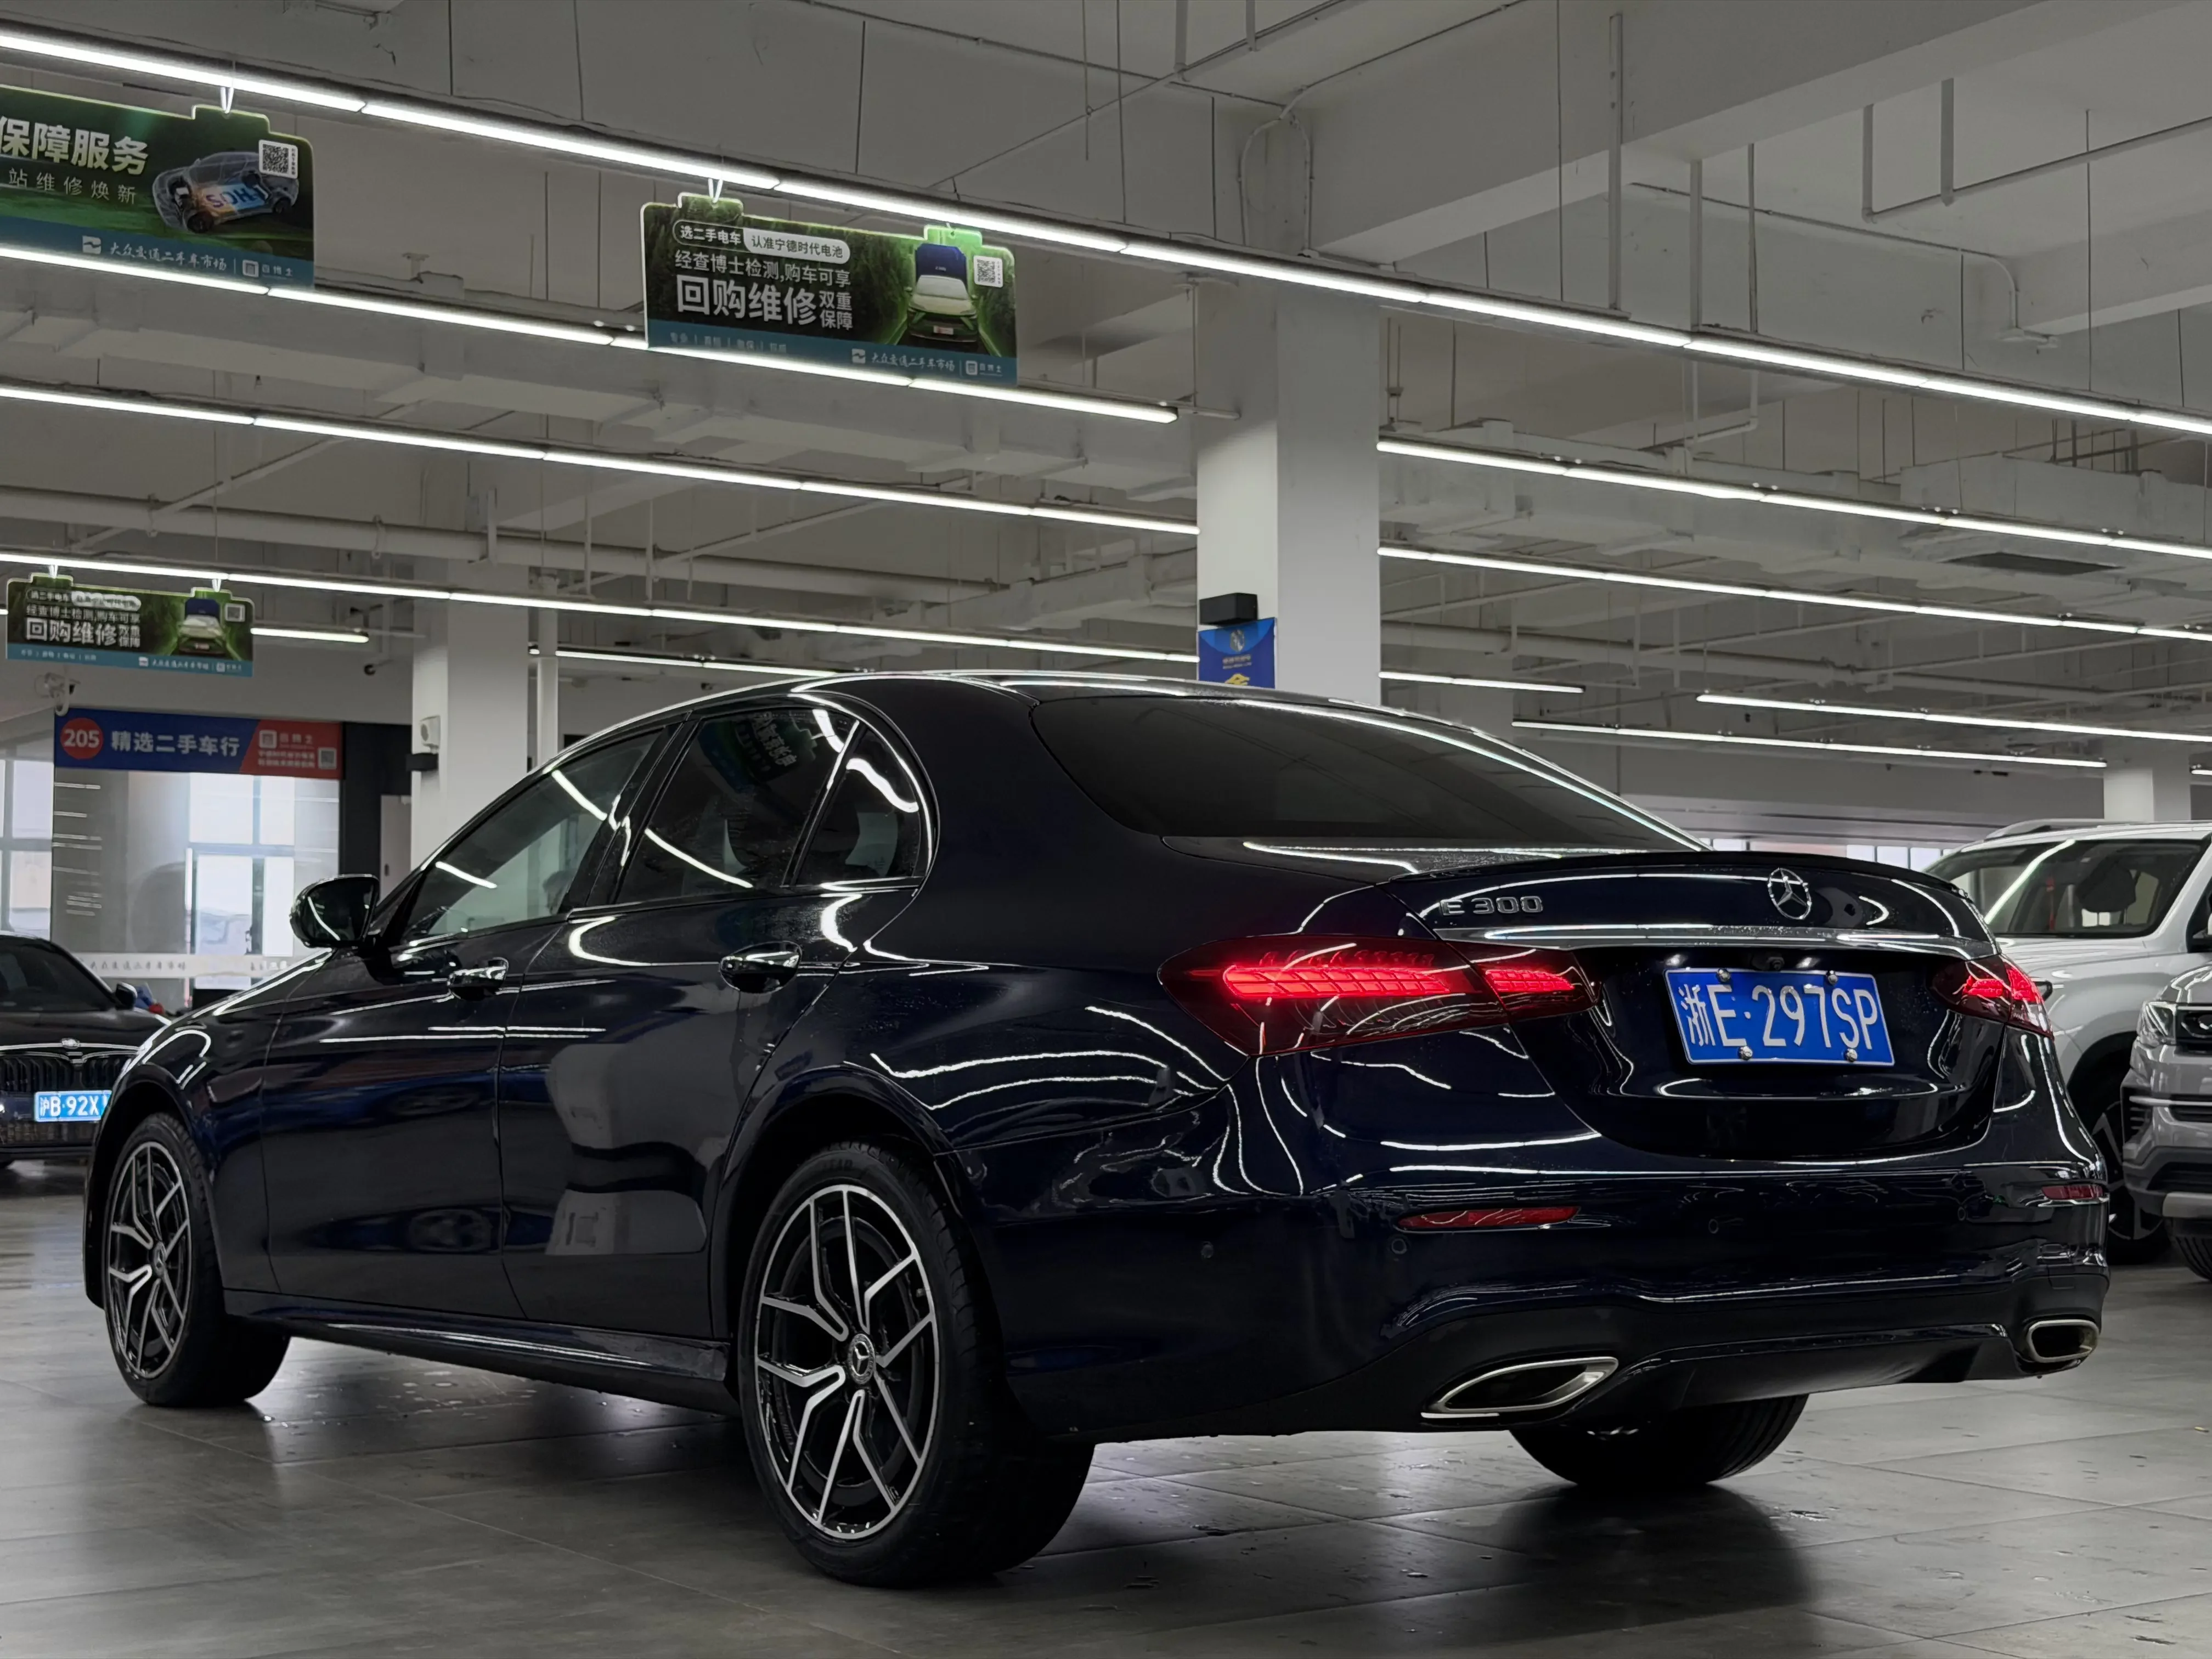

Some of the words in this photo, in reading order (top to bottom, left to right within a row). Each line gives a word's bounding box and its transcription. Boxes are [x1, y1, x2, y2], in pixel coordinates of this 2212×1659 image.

[0, 116, 149, 175] 保障服务
[9, 167, 137, 204] 站维修焕新
[680, 225, 741, 245] 选二手电车
[752, 235, 843, 258] 认准宁德时代电池
[676, 274, 816, 325] 回购维修
[819, 290, 853, 311] 双重
[820, 309, 853, 330] 保障
[26, 617, 117, 646] 回购维修
[64, 729, 100, 748] 205
[112, 731, 239, 757] 精选二手车行
[1440, 899, 1465, 916] E
[1471, 896, 1543, 914] 300
